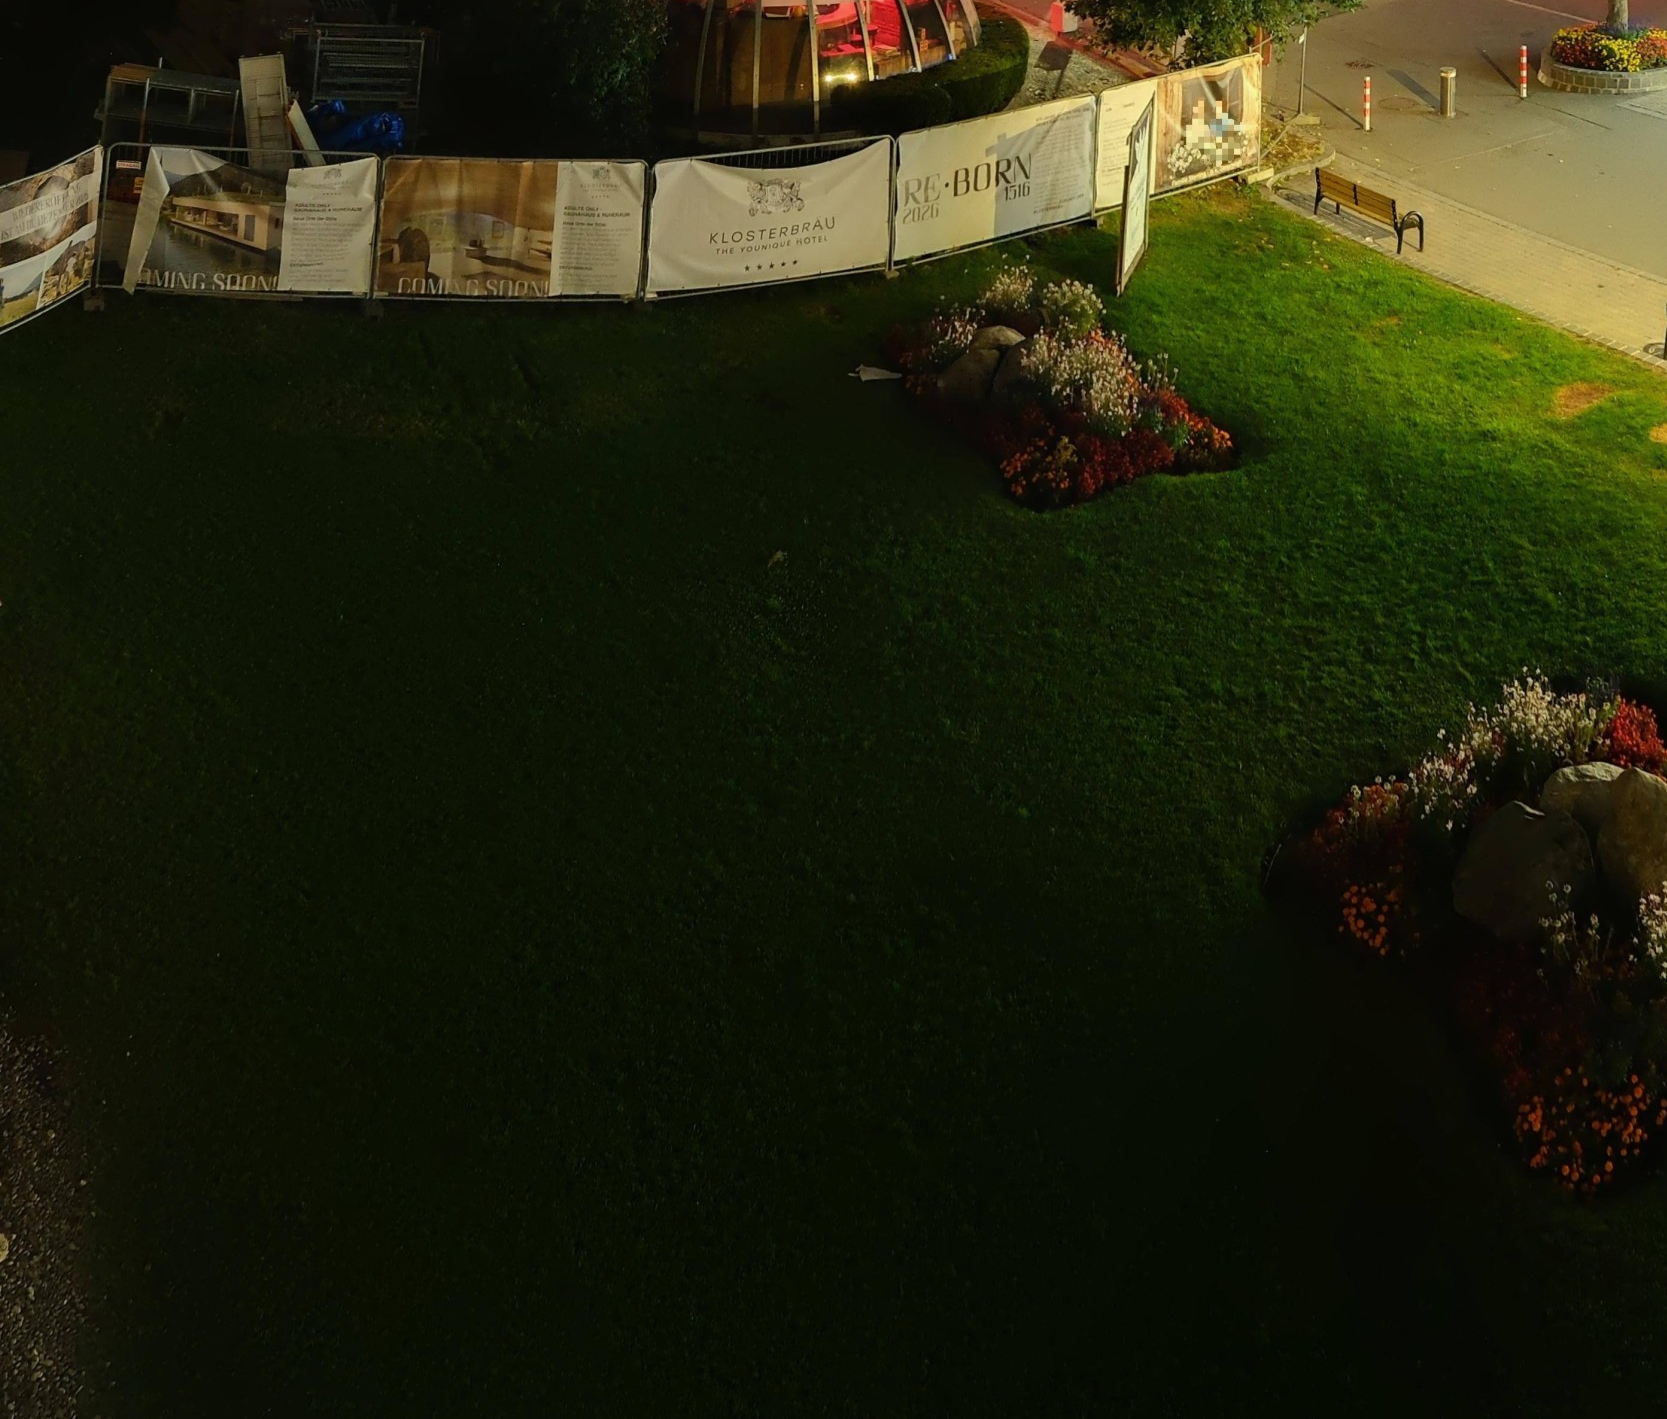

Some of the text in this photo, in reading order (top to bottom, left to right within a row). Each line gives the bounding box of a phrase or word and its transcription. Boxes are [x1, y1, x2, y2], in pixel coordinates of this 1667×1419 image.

[1005, 182, 1031, 202] 1516
[902, 203, 940, 225] 2026
[709, 216, 836, 245] KLOSTERBRÄU
[796, 236, 828, 246] HOTEL
